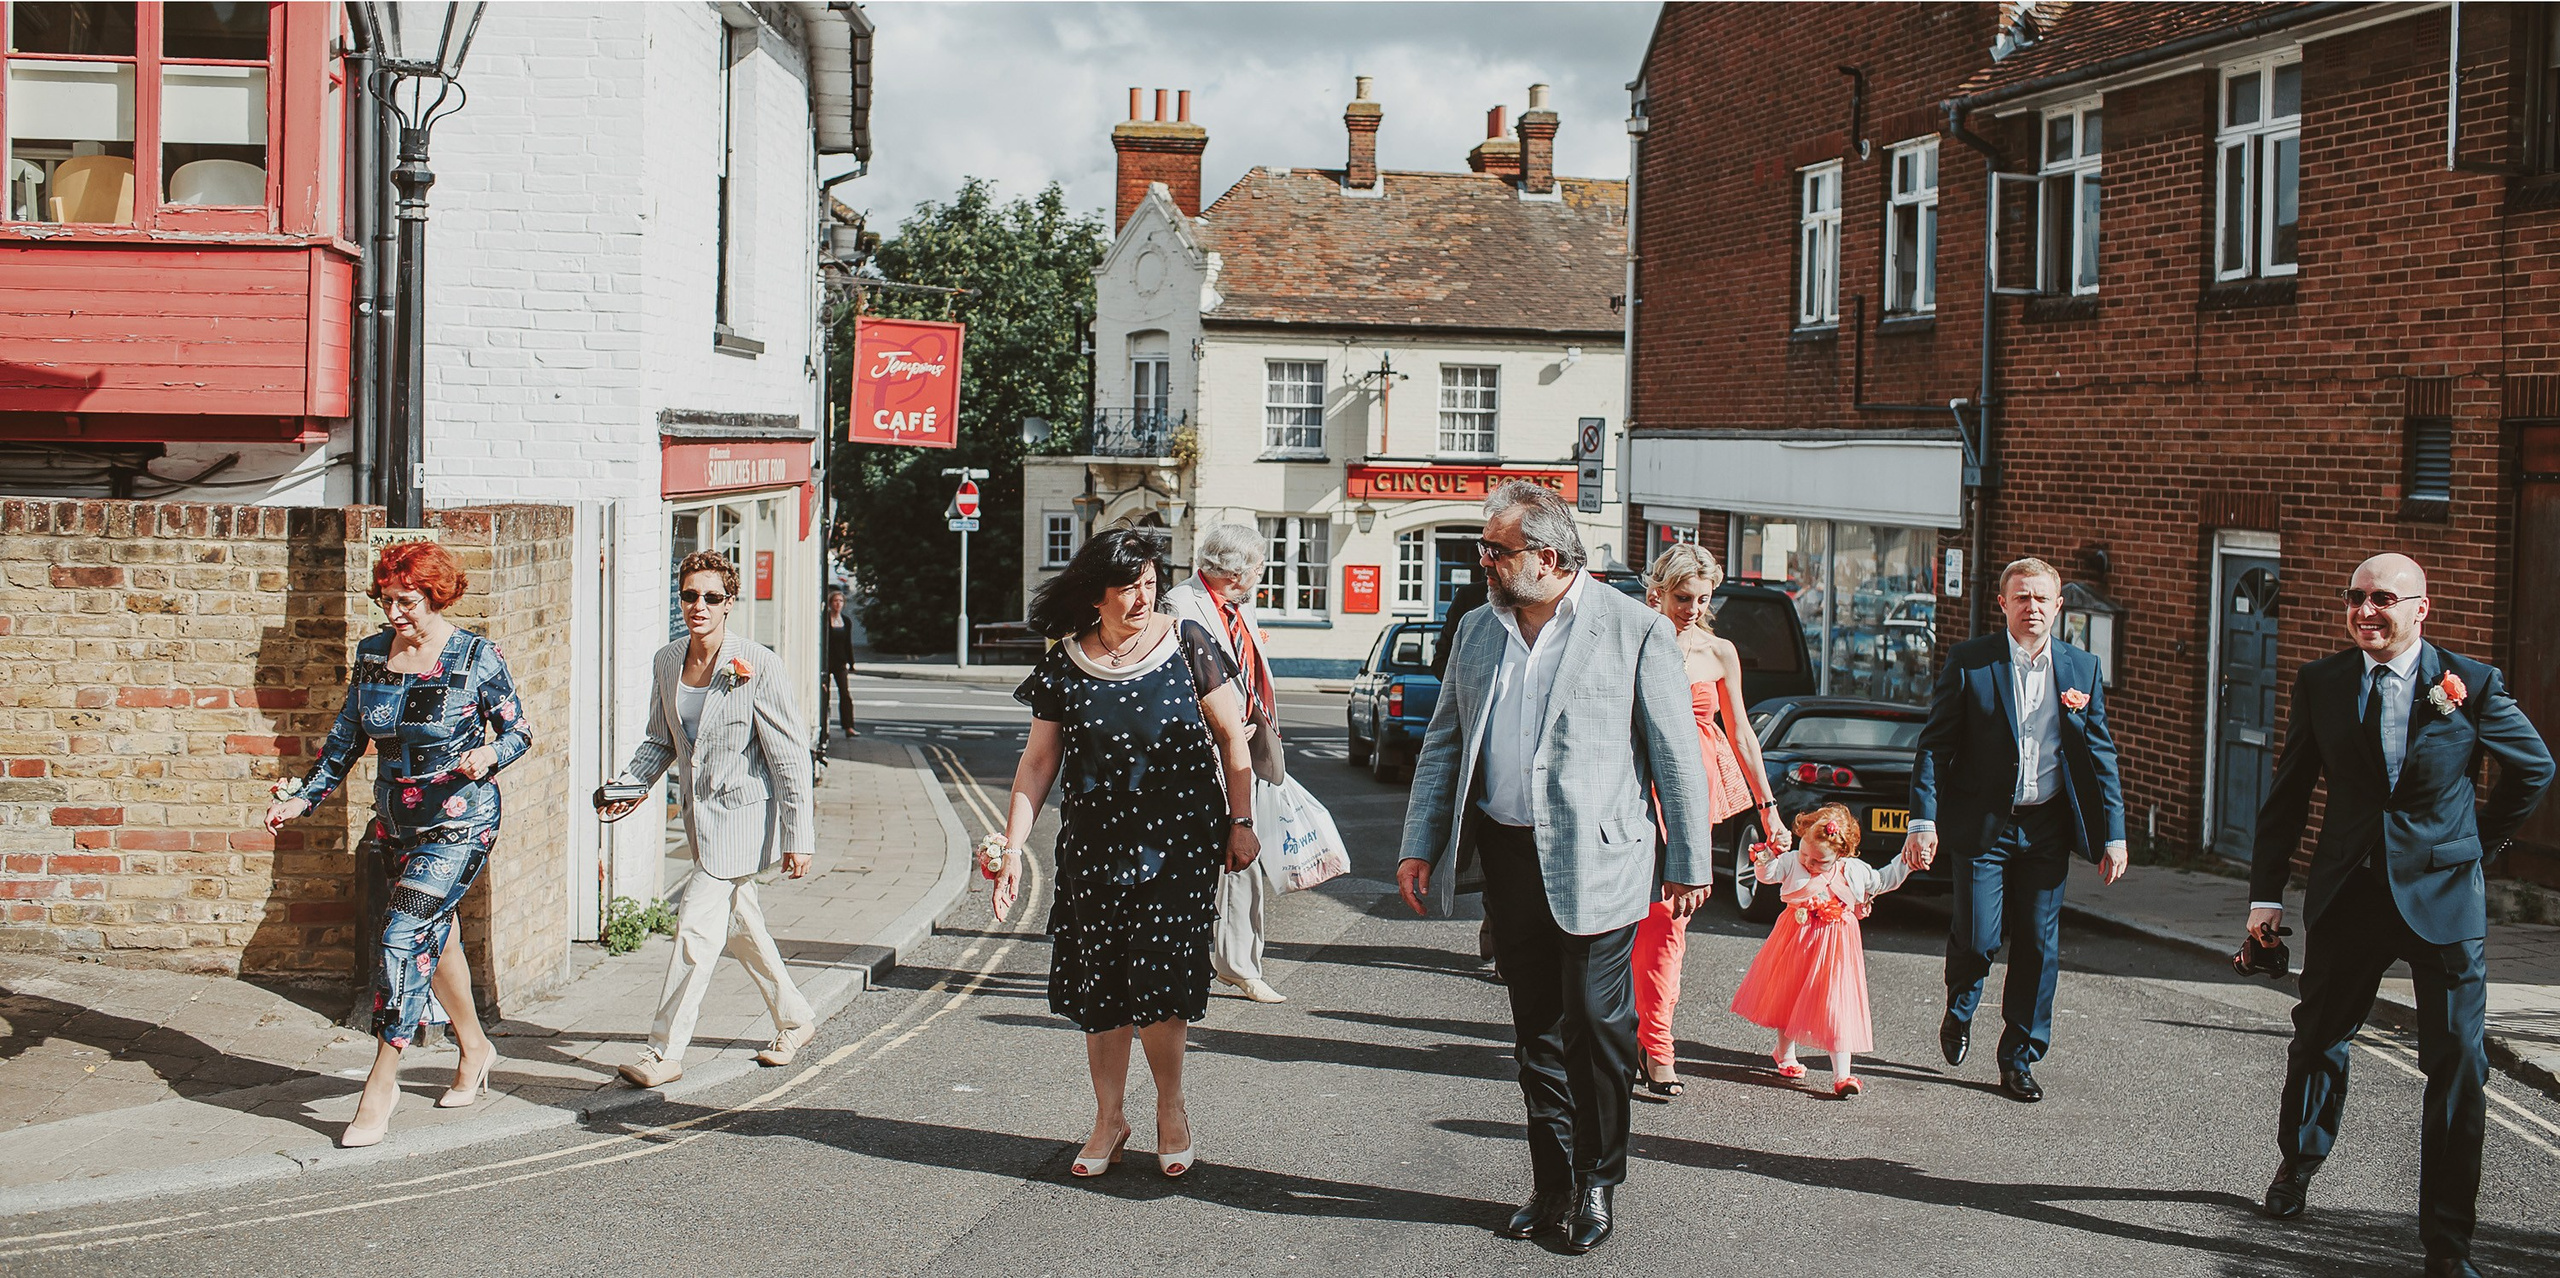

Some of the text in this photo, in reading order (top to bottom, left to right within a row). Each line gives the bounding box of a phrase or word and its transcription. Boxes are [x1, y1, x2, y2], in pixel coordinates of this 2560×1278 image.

[873, 406, 937, 433] CAFÉ
[708, 458, 786, 487] SANDWICHES & HOT FOOD
[1375, 473, 1469, 493] CINQUE
[1581, 499, 1597, 508] ENDS
